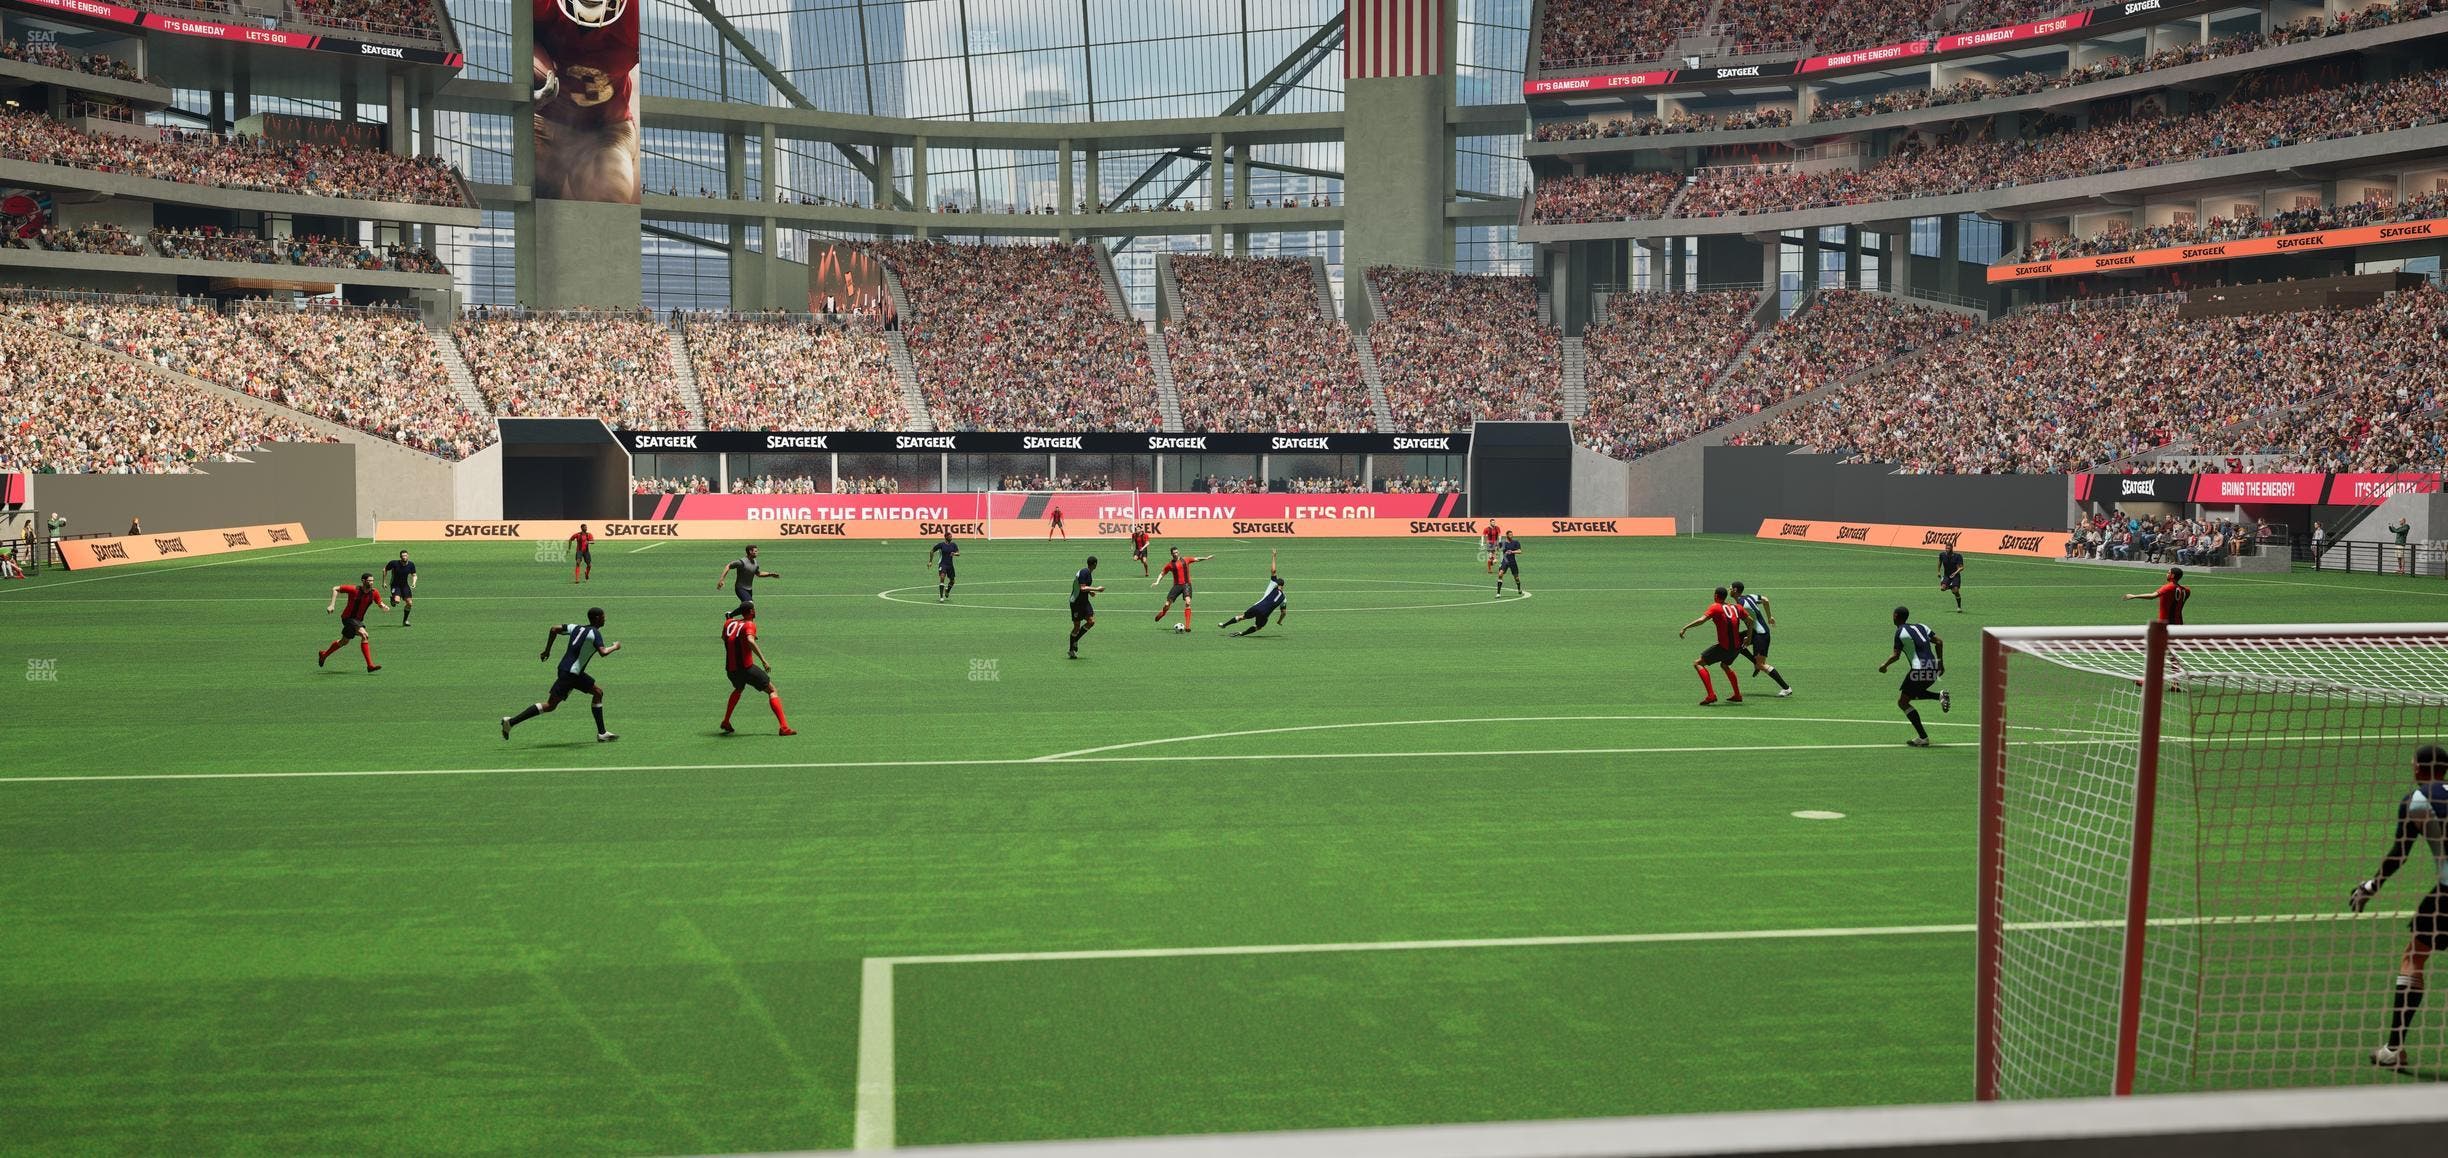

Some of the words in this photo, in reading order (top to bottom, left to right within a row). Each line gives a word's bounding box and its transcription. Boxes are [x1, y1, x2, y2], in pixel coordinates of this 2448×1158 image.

[78, 2, 111, 16] ENERGY!
[2124, 0, 2160, 15] SEATGEEK
[164, 20, 180, 31] IT'S
[182, 22, 225, 36] GAMEDAY
[246, 31, 270, 42] LET'S
[271, 34, 287, 44] GO!
[1957, 36, 1973, 46] IT'S
[1974, 29, 2015, 44] GAMEDAY
[2034, 23, 2054, 34] LET'S
[2055, 20, 2067, 31] GO!
[361, 44, 403, 58] SEATGEEK
[1828, 56, 1851, 67] BRING
[1852, 54, 1868, 63] THE
[1868, 48, 1901, 62] ENERGY!
[1717, 66, 1760, 78] SEATGEEK
[566, 65, 615, 107] 3
[1536, 81, 1552, 91] IT'S
[1552, 80, 1590, 90] GAMEDAY
[1608, 76, 1630, 86] LET'S
[1631, 75, 1645, 85] GO!
[2380, 223, 2431, 238] SEATGEEK
[2276, 235, 2324, 249] SEATGEEK
[2182, 245, 2225, 259] SEATGEEK
[2095, 255, 2135, 268] SEATGEEK
[2016, 264, 2052, 276] SEATGEEK
[635, 435, 697, 449] SEATGEEK
[766, 435, 828, 449] SEATGEEK
[896, 435, 956, 449] SEATGEEK
[1023, 436, 1083, 450] SEATGEEK
[1148, 436, 1207, 450] SEATGEEK
[1272, 437, 1329, 450] SEATGEEK
[1393, 437, 1449, 450] SEATGEEK
[2121, 479, 2155, 496] SEATGEEK
[2221, 481, 2244, 496] BRING
[2245, 481, 2261, 496] THE
[2261, 482, 2295, 497] ENERGY!
[2355, 482, 2372, 498] IT'S
[444, 523, 520, 537] SEATGEEK
[605, 523, 679, 537] SEATGEEK
[780, 522, 846, 536] SEATGEEK
[919, 522, 984, 536] SEATGEEK
[1232, 522, 1295, 535] SEATGEEK
[1410, 521, 1477, 533] SEATGEEK
[1552, 520, 1618, 533] SEATGEEK
[1780, 522, 1810, 537] SEATGEEK
[1836, 525, 1870, 542] SEATGEEK
[223, 530, 251, 548] SEATGEEK
[267, 527, 293, 543] SEATGEEK
[1922, 529, 1962, 547] SEATGEEK
[154, 535, 188, 556] SEATGEEK
[1998, 533, 2044, 552] SEATGEEK
[91, 541, 130, 562] SEATGEEK
[1722, 604, 1739, 619] 01
[726, 621, 745, 637] 01
